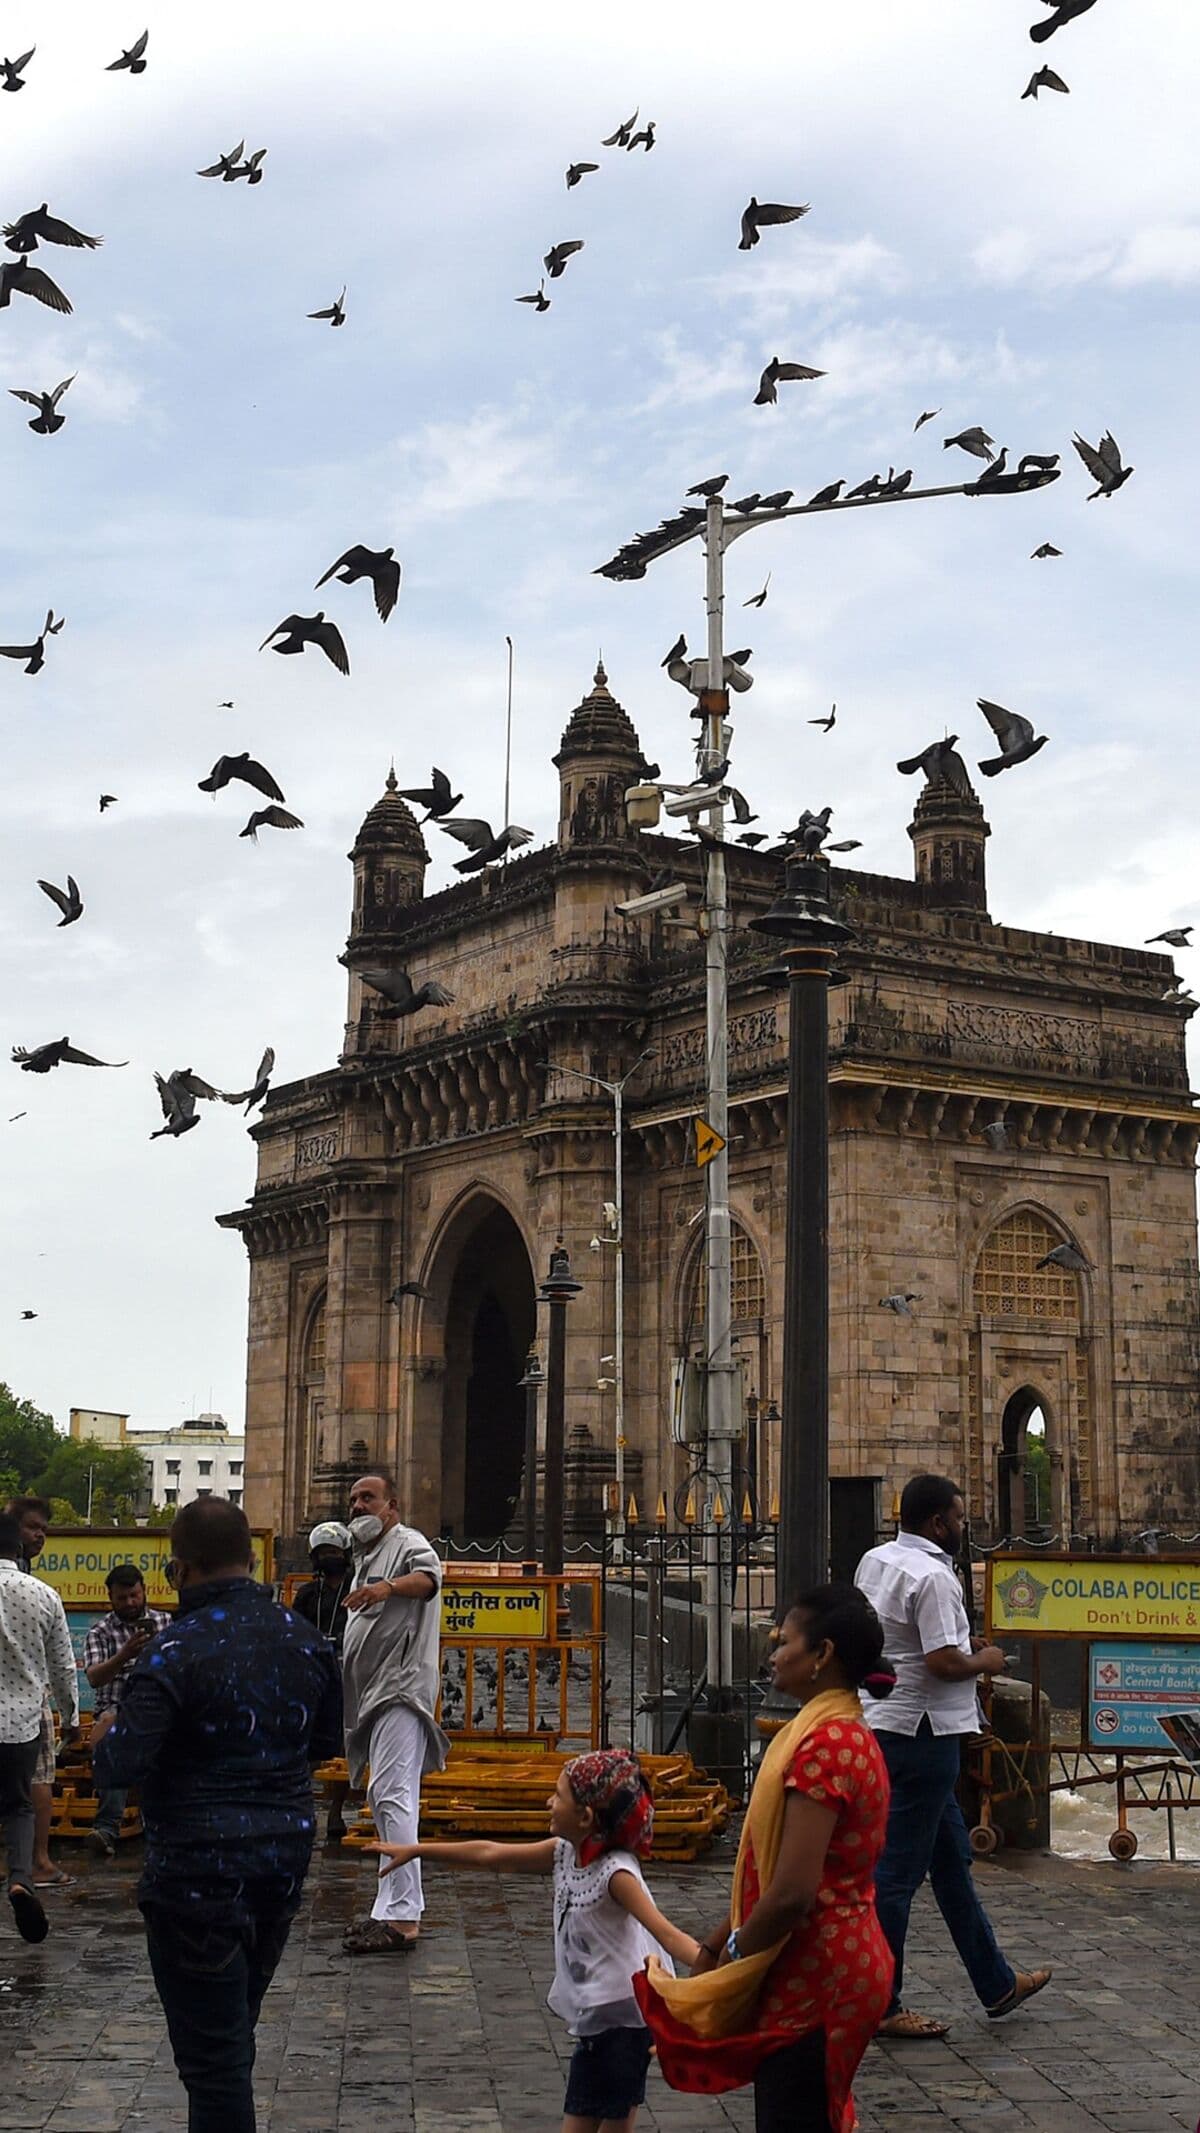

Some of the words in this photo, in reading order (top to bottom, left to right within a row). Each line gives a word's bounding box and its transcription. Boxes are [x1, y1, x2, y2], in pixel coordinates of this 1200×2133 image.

[76, 1582, 107, 1596] Drin
[1051, 1579, 1128, 1599] COLABA
[1133, 1580, 1200, 1601] POLICE
[443, 1590, 500, 1610] पोलीस
[505, 1591, 541, 1611] ठाणे
[445, 1611, 475, 1632] मुंबई
[1087, 1609, 1132, 1625] Don't
[1136, 1609, 1180, 1627] Drink
[1185, 1611, 1198, 1626] &
[1125, 1676, 1164, 1688] Central
[1166, 1677, 1194, 1689] Bank
[1122, 1724, 1137, 1734] DO
[1138, 1724, 1158, 1735] NOT
